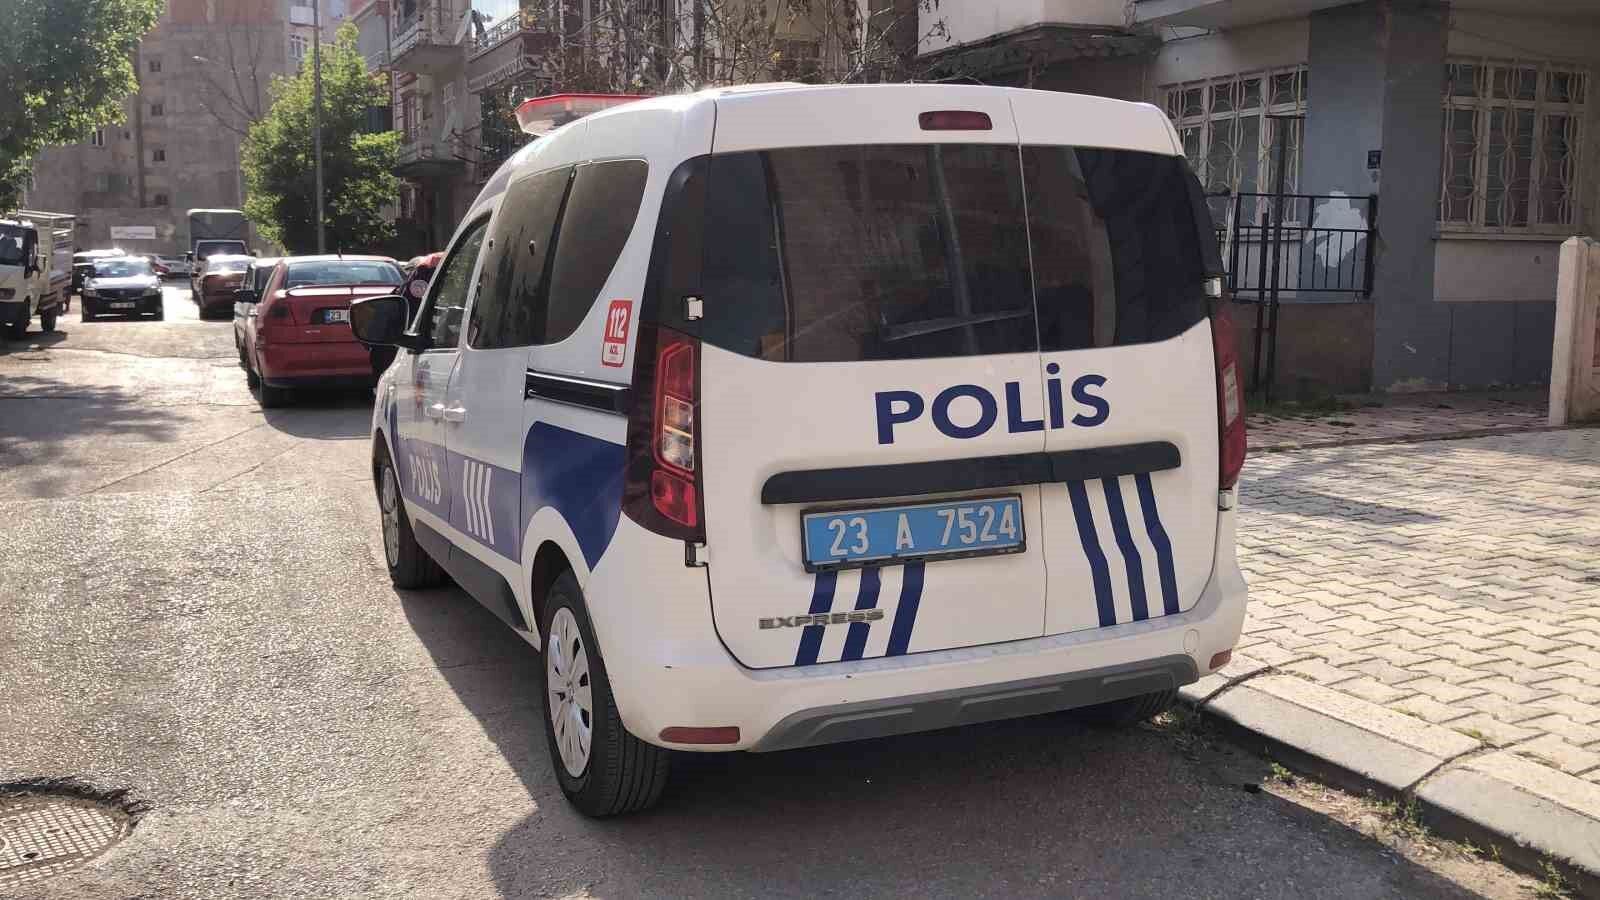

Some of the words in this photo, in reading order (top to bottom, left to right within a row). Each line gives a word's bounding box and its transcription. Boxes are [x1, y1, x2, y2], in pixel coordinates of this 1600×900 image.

[608, 307, 628, 338] 112
[874, 362, 1110, 444] POLİS
[827, 517, 870, 556] 23
[895, 513, 915, 550] A
[937, 504, 1017, 546] 7524
[759, 608, 884, 630] EXPRESS
